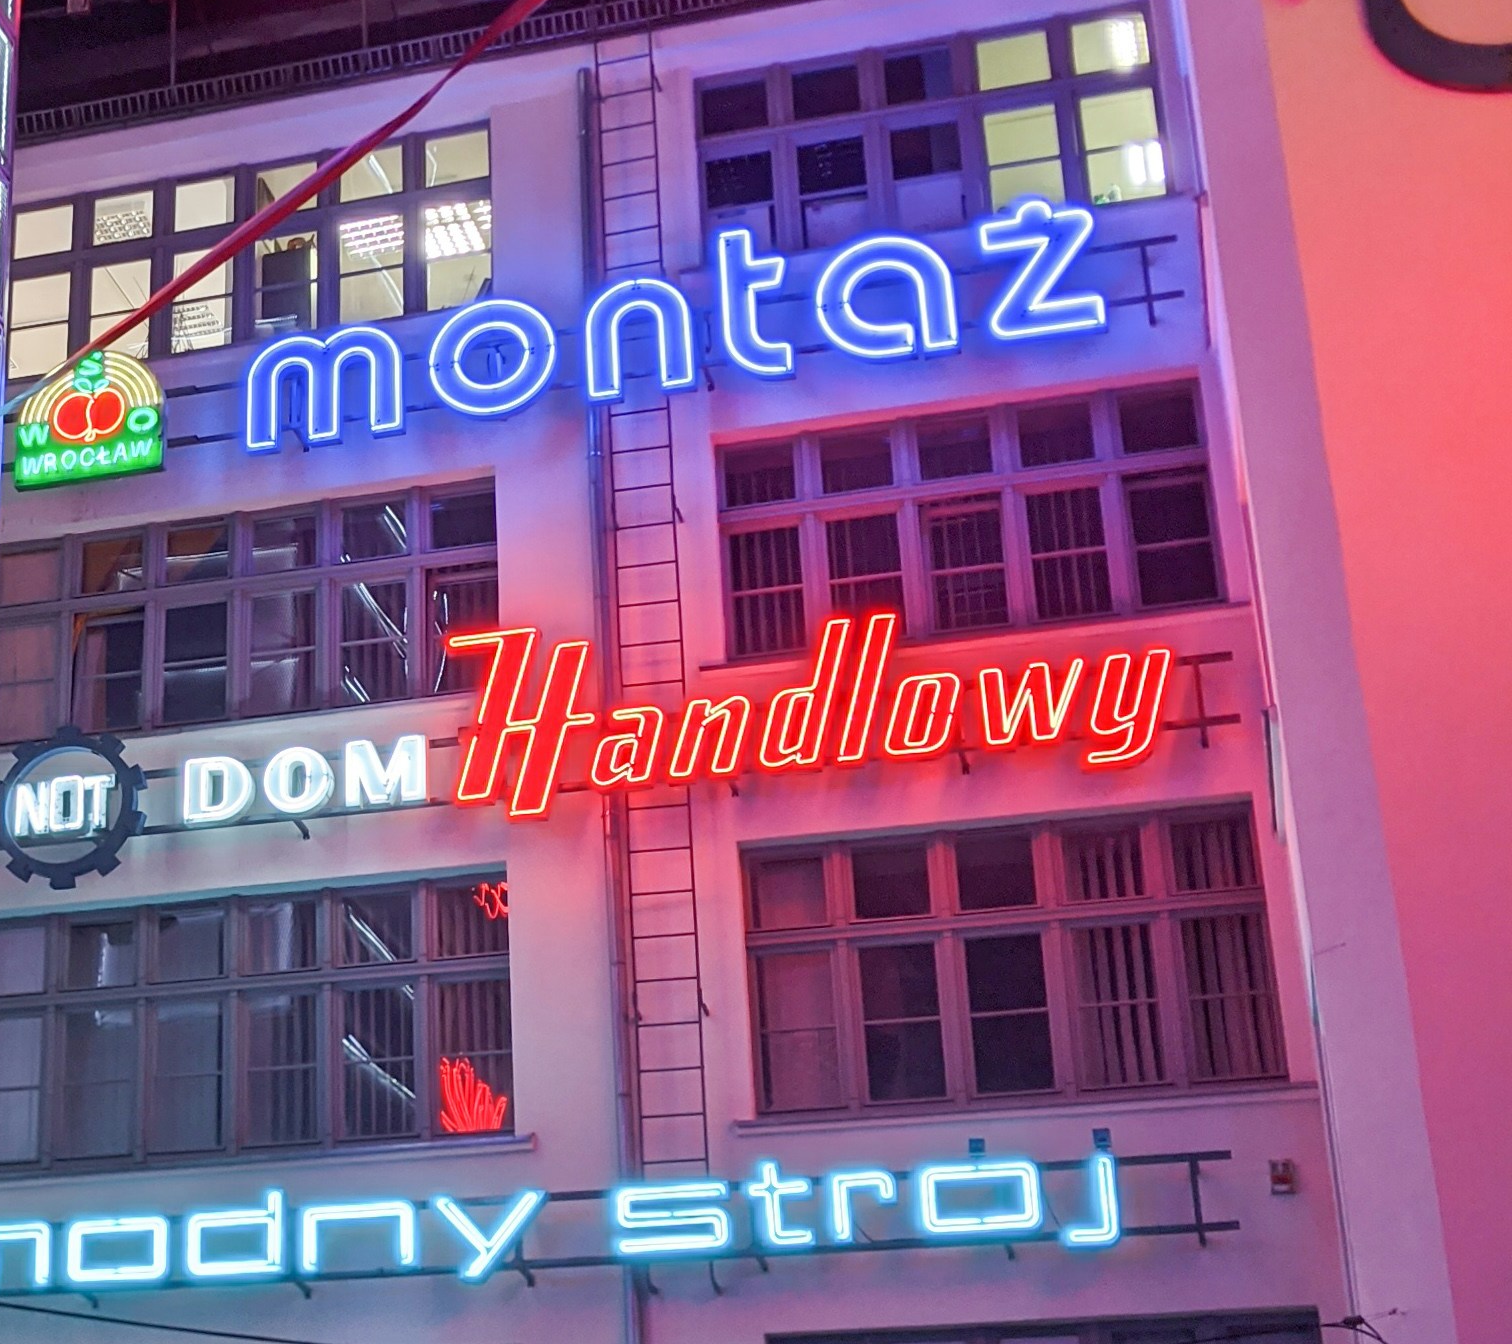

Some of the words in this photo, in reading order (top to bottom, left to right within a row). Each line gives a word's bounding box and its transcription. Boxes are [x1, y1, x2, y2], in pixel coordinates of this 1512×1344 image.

[21, 438, 154, 476] WROCŁAW
[182, 733, 428, 825] DOM
[446, 611, 1173, 820] Handlowy
[13, 771, 118, 838] NOT
